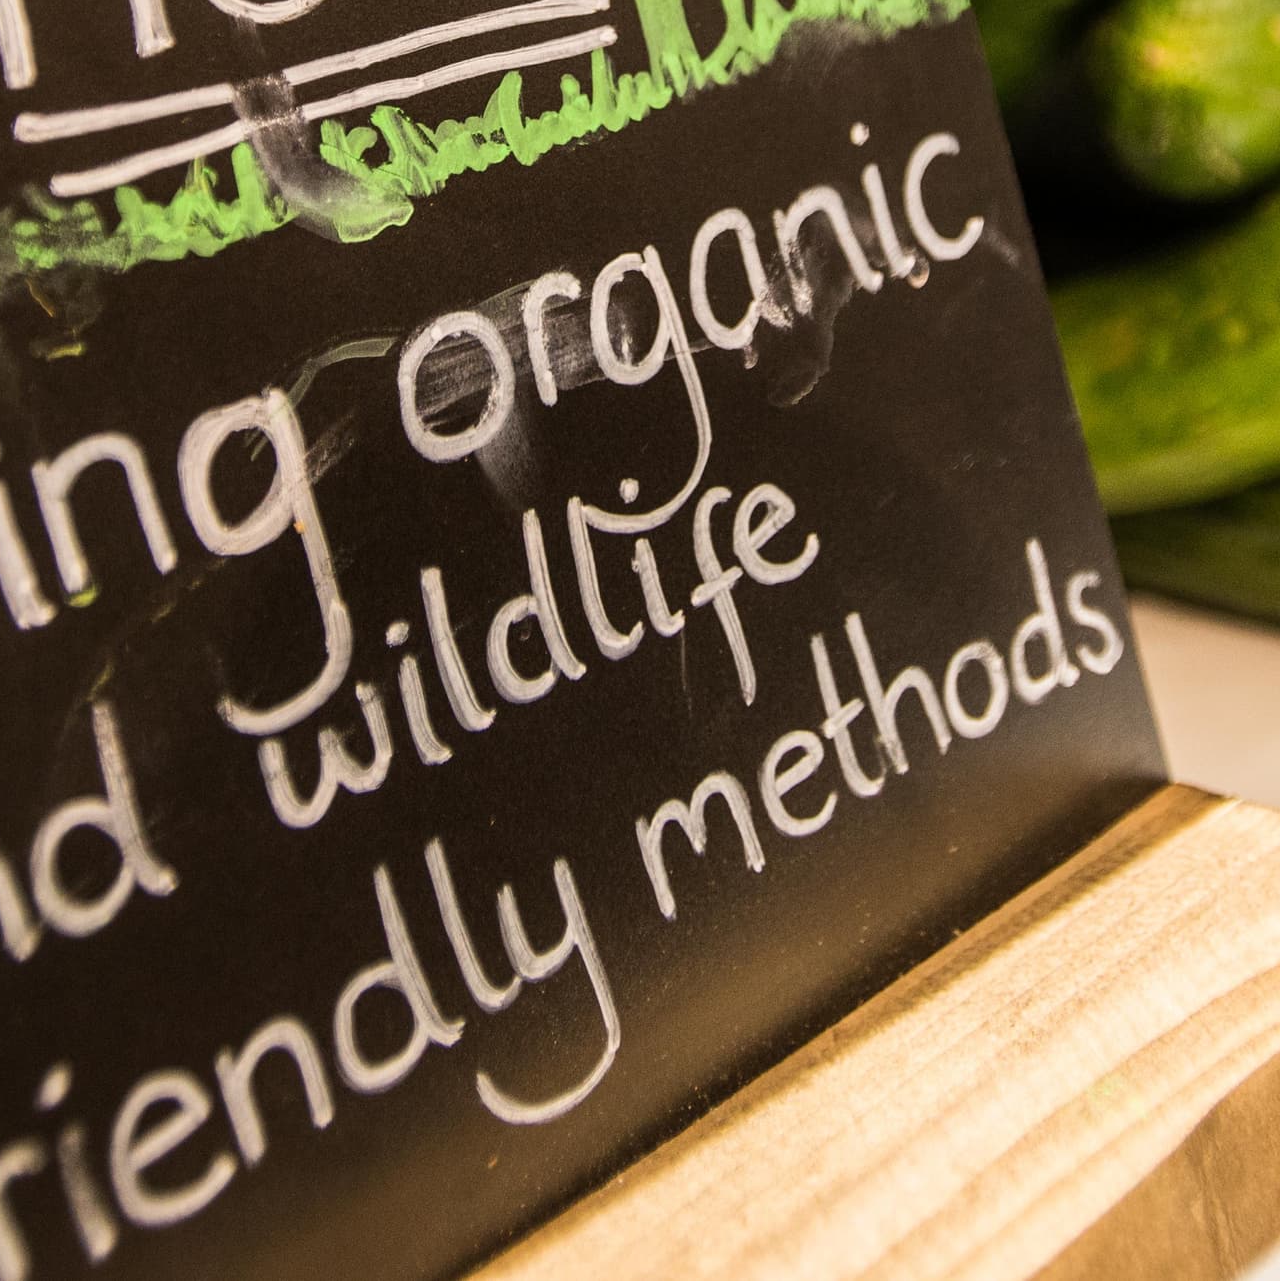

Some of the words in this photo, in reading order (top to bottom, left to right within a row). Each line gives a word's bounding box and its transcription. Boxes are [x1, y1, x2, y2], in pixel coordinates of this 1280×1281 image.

[397, 126, 985, 536] organic
[258, 477, 821, 831] wildlife
[635, 537, 1124, 921] methods
